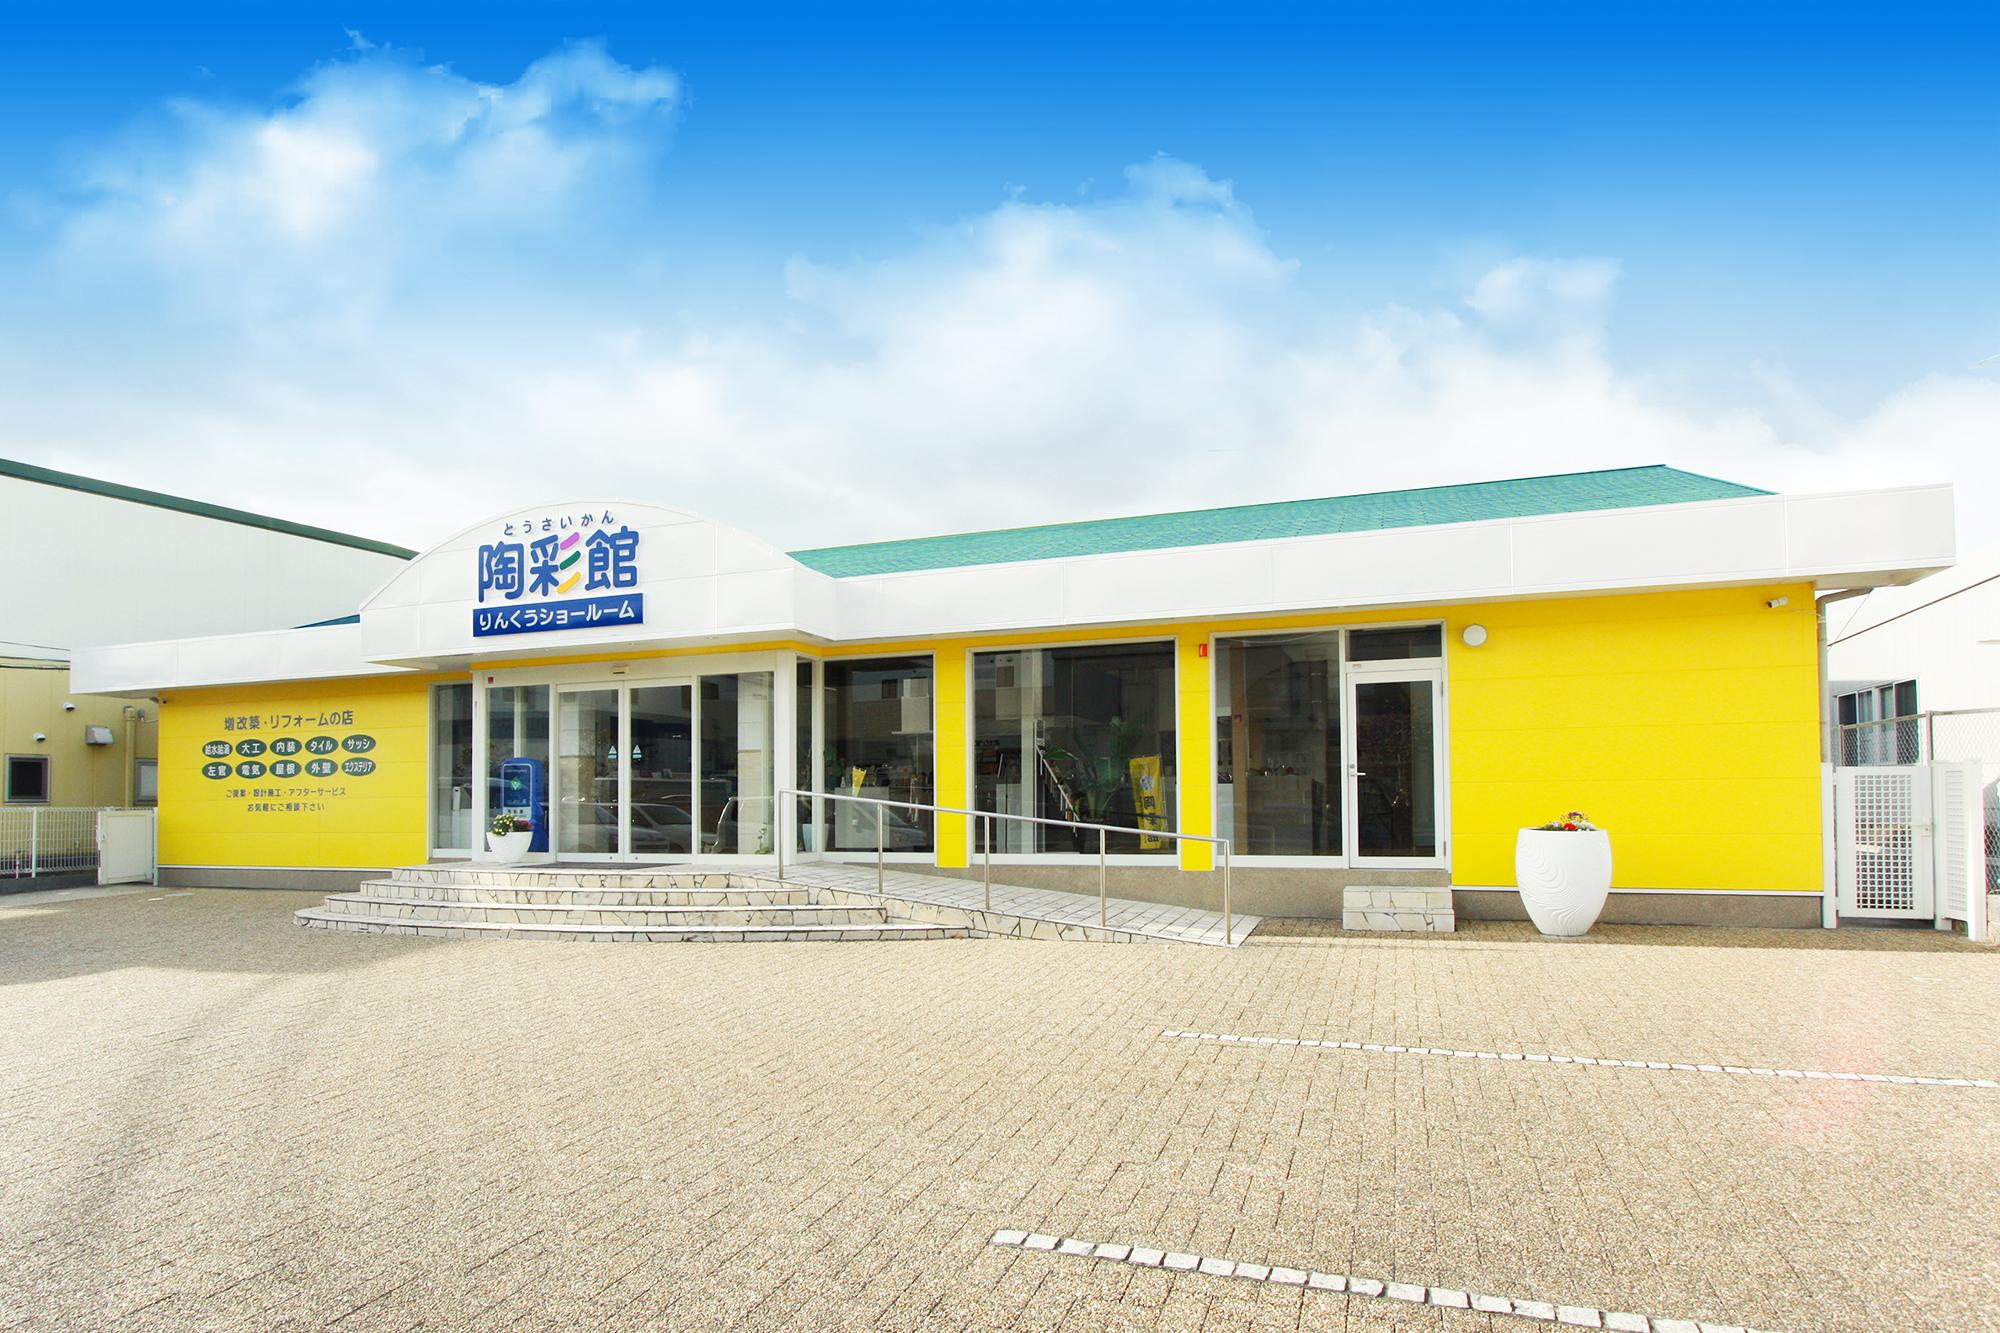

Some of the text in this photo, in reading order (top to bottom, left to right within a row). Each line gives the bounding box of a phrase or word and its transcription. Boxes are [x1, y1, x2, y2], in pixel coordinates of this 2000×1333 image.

[504, 510, 615, 536] とうさいかん
[478, 525, 640, 603] 陶彩館
[479, 600, 636, 631] りんくうショールーム
[224, 710, 354, 732] 増改築・リフォームの店
[241, 742, 261, 754] 大工
[276, 741, 296, 753] 内装
[310, 740, 333, 751] タイル
[347, 738, 371, 750] サッシ
[207, 761, 373, 777] 左官 電気 屋根 外壁 エクステリア
